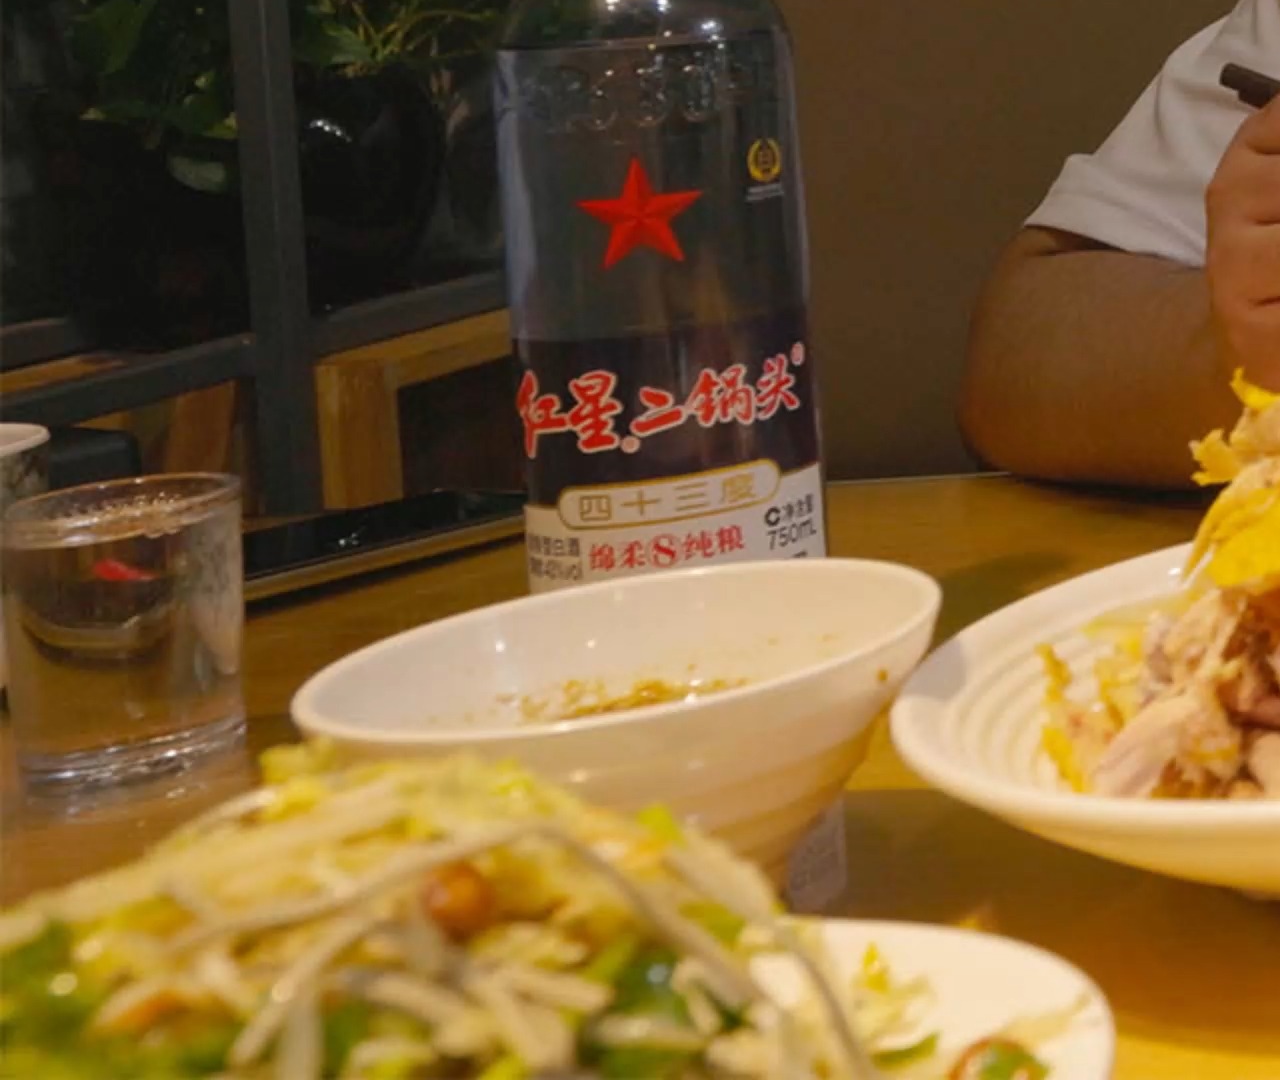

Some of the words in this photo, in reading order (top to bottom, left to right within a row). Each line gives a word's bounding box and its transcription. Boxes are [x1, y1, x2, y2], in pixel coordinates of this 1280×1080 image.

[578, 471, 757, 522] 四十三度
[588, 523, 745, 572] 绵柔8纯粮
